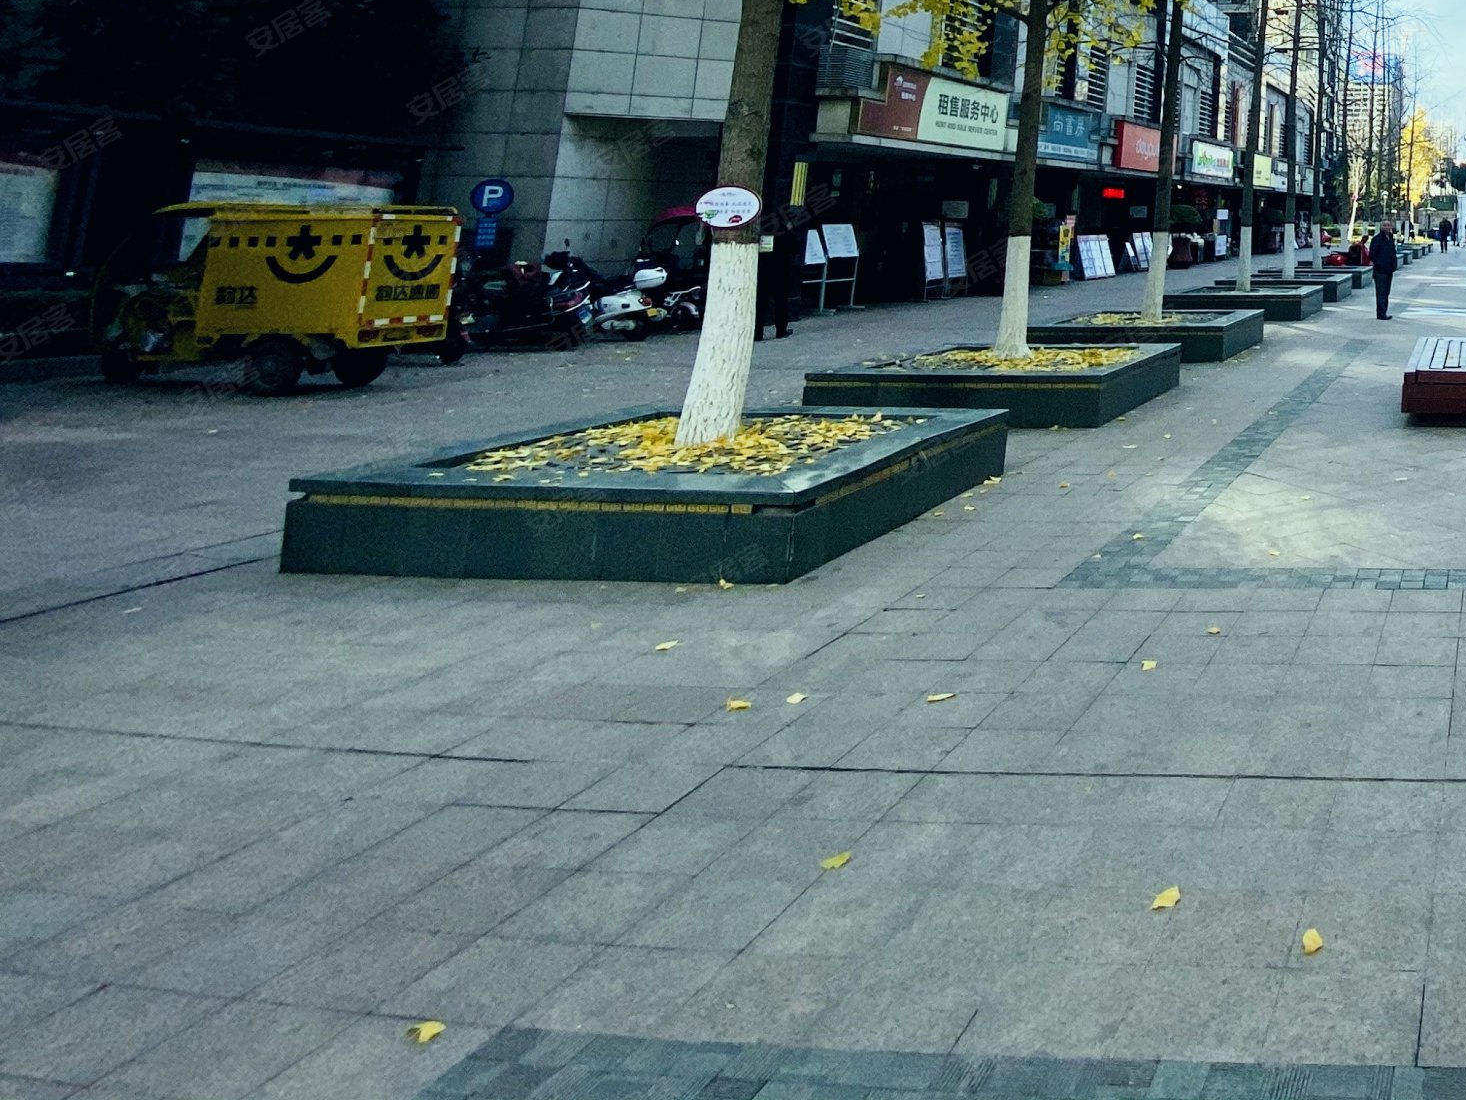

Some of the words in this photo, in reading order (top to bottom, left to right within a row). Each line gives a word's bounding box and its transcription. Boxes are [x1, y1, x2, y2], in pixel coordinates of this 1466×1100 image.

[938, 94, 999, 124] 租售服务中心
[482, 186, 504, 207] P
